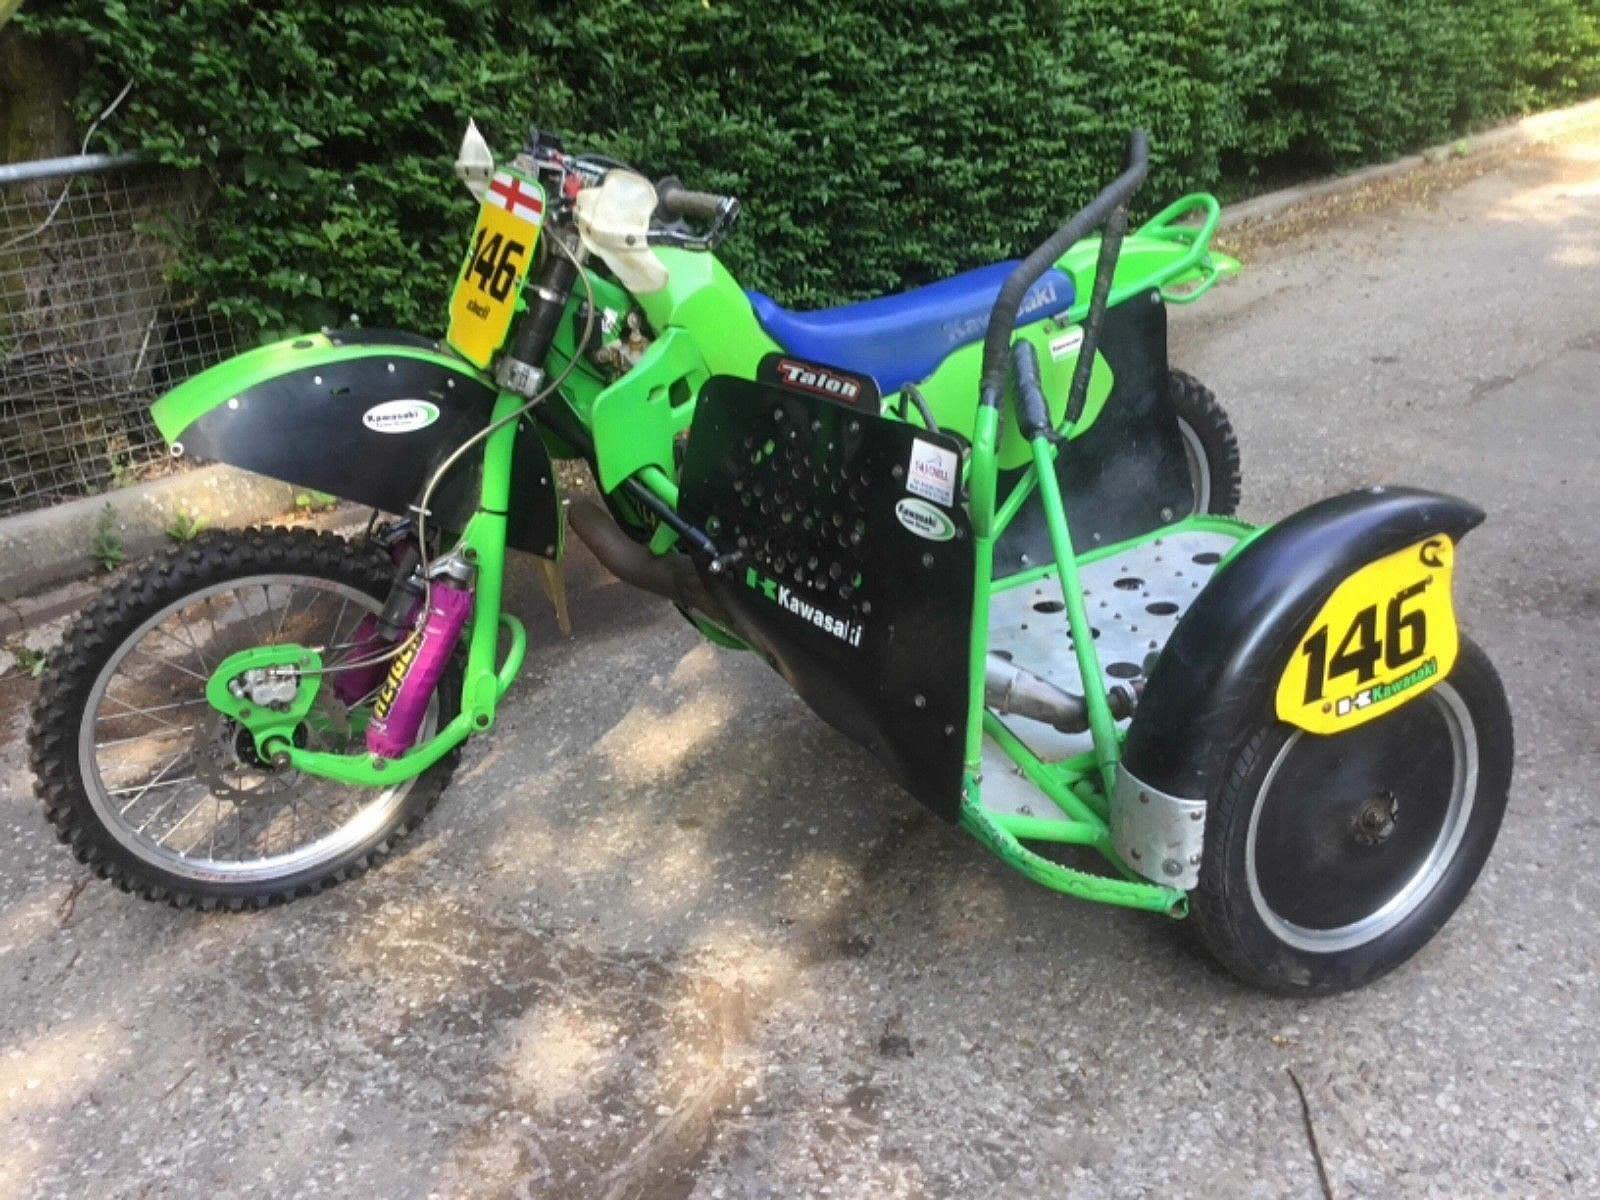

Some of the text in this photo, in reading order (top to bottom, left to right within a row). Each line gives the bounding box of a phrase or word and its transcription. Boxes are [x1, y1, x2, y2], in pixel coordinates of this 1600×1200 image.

[464, 227, 525, 304] 146
[781, 364, 857, 397] Talon
[778, 584, 862, 647] Kawasaki
[1302, 577, 1427, 706] 146
[1371, 656, 1438, 704] Kawasaki
